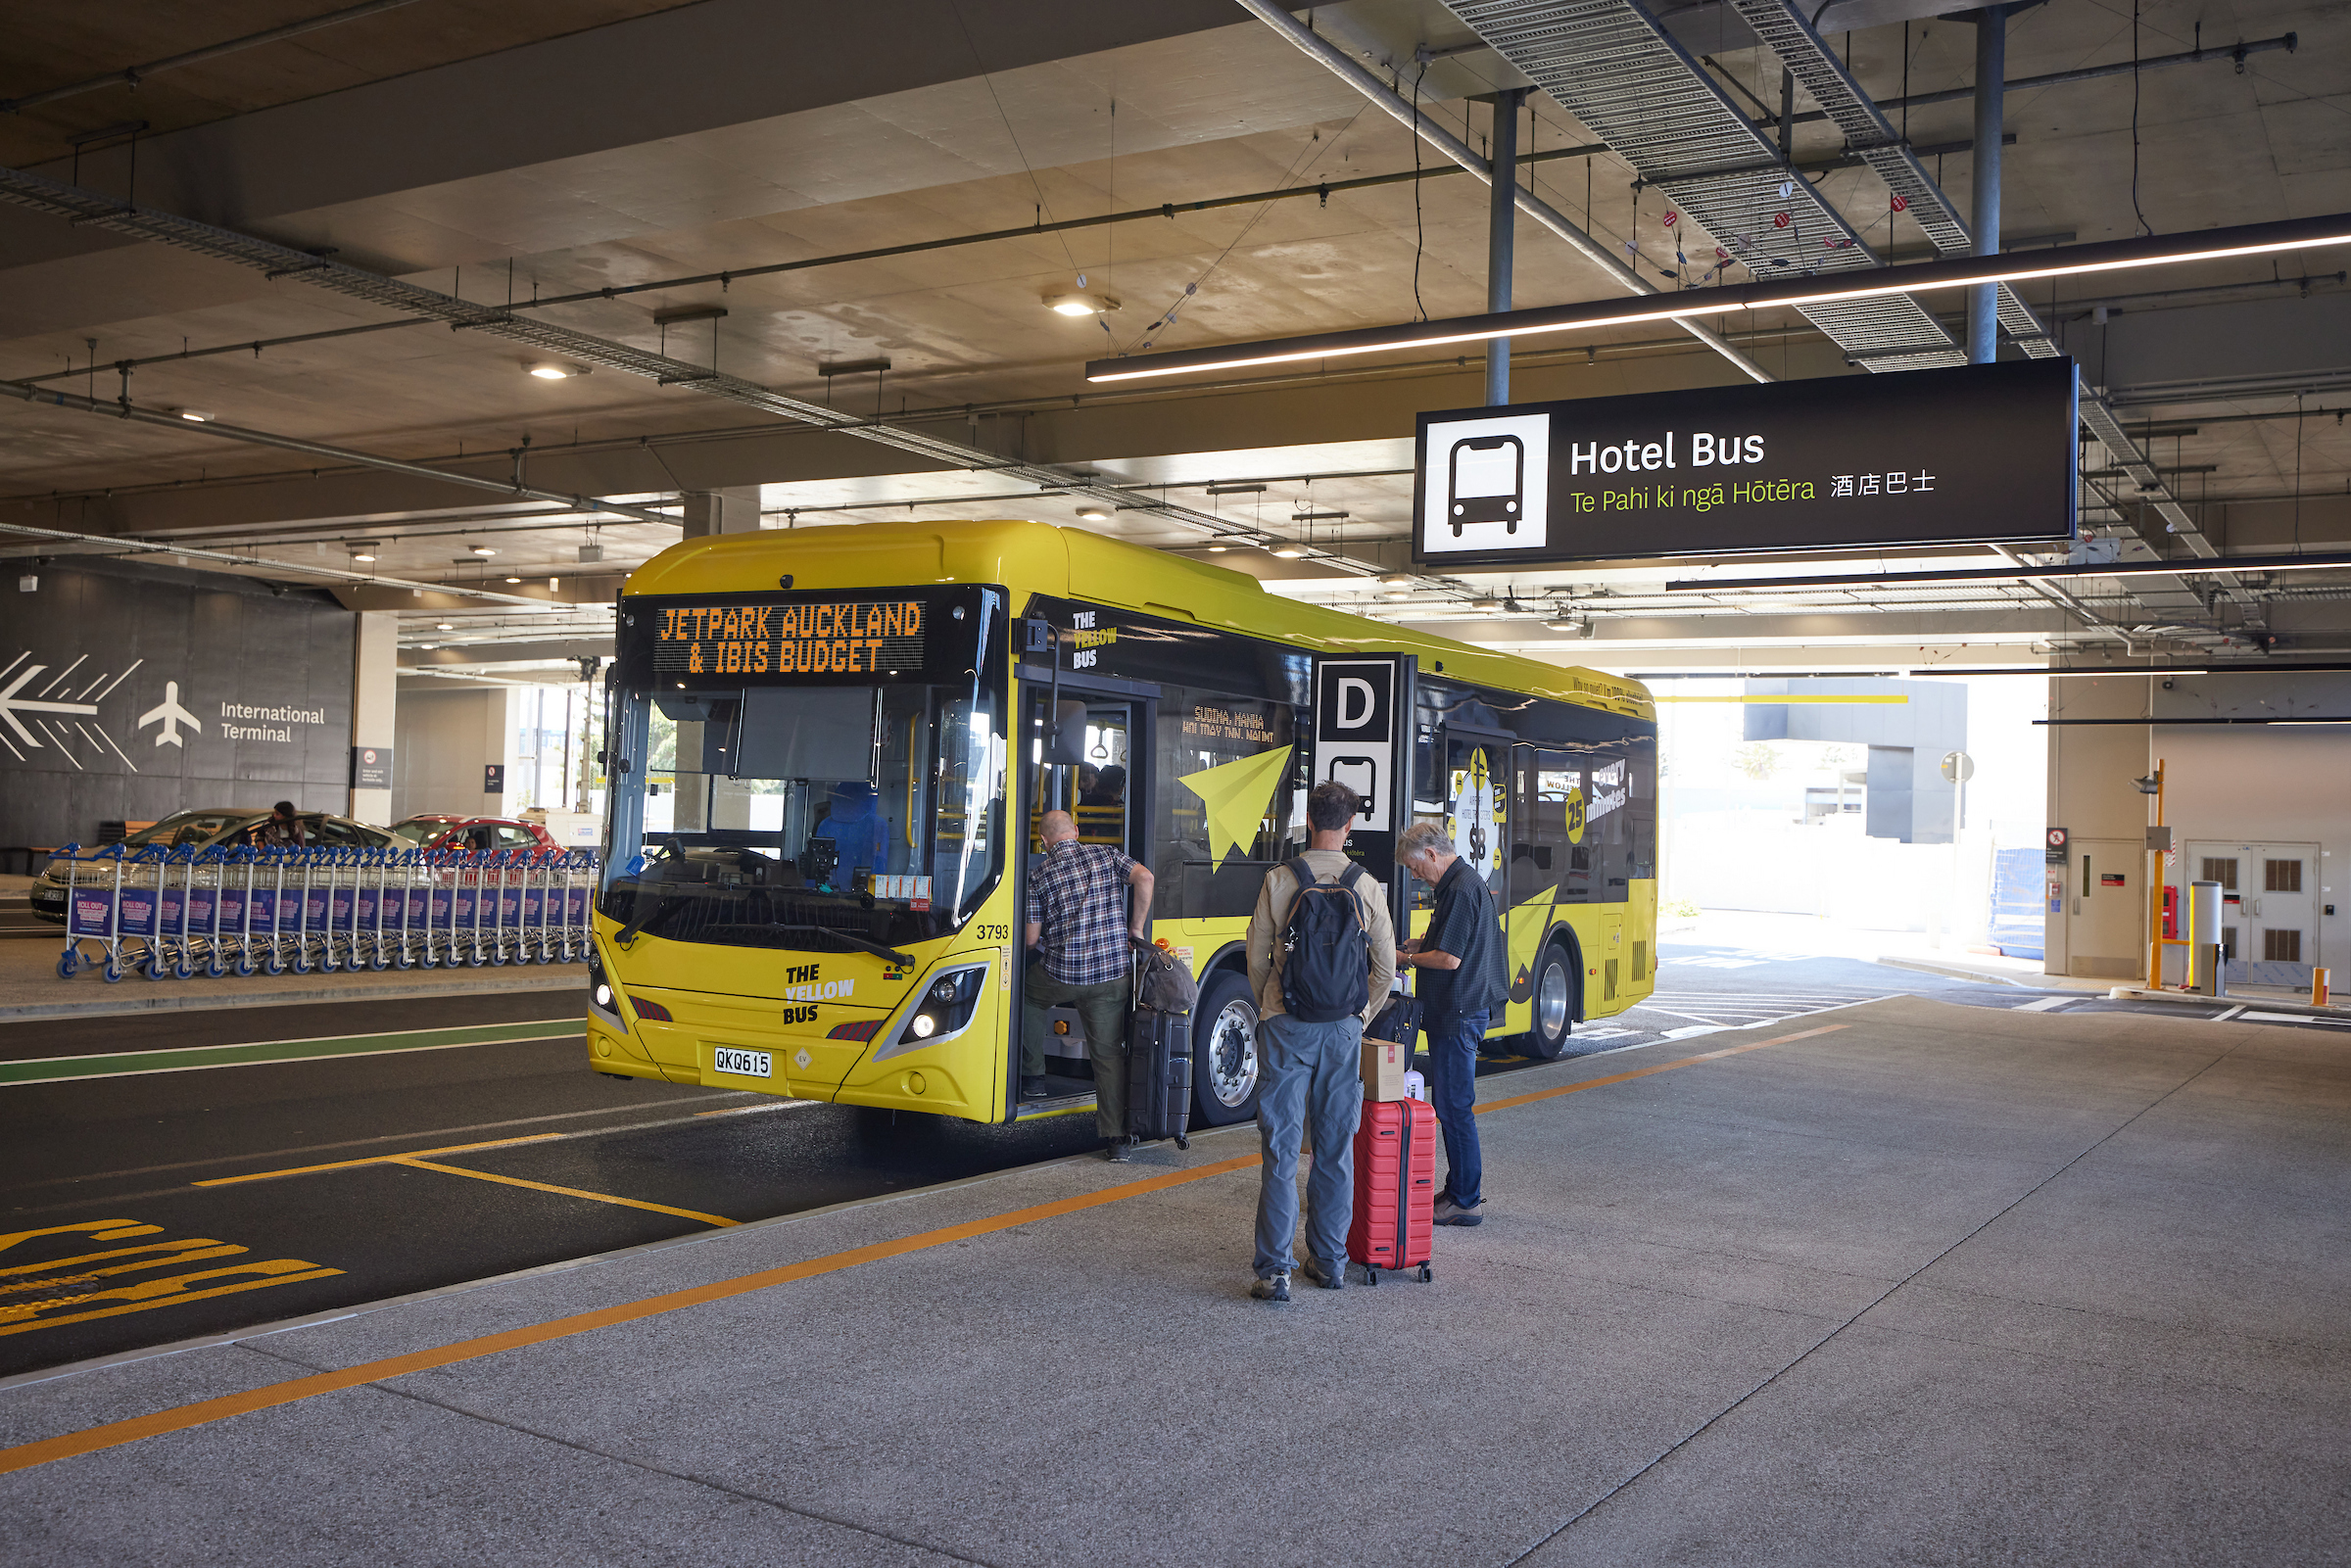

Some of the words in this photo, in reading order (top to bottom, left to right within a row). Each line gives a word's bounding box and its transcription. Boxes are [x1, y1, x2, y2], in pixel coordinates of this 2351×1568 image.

[1569, 432, 1676, 476] Hotel
[1691, 432, 1765, 468] Bus
[1570, 492, 1596, 514] Te
[1602, 488, 1650, 511] Pahi
[1655, 484, 1675, 509] ki
[1682, 483, 1725, 514] ngā
[1732, 478, 1815, 505] Hōtēra
[1829, 468, 1938, 499] 酒店巴士
[659, 606, 770, 641] JETPARK
[781, 602, 922, 637] AUCKLAND
[1073, 610, 1096, 630] THE
[1073, 627, 1118, 650] YELLOW
[689, 643, 704, 674] &
[714, 641, 770, 674] IBIS
[779, 639, 884, 673] BUDGET
[1073, 649, 1097, 670] BUS
[221, 701, 325, 726] International
[1336, 677, 1376, 730] D
[221, 723, 292, 744] Terminal
[1598, 758, 1626, 787] every
[1567, 799, 1583, 832] 25
[1586, 787, 1626, 824] minutes
[1469, 823, 1486, 864] $8
[976, 924, 1009, 940] 3793
[786, 963, 821, 984] THE
[785, 977, 855, 1005] YELLOW
[783, 1004, 819, 1025] BUS
[716, 1050, 770, 1076] QKQ615
